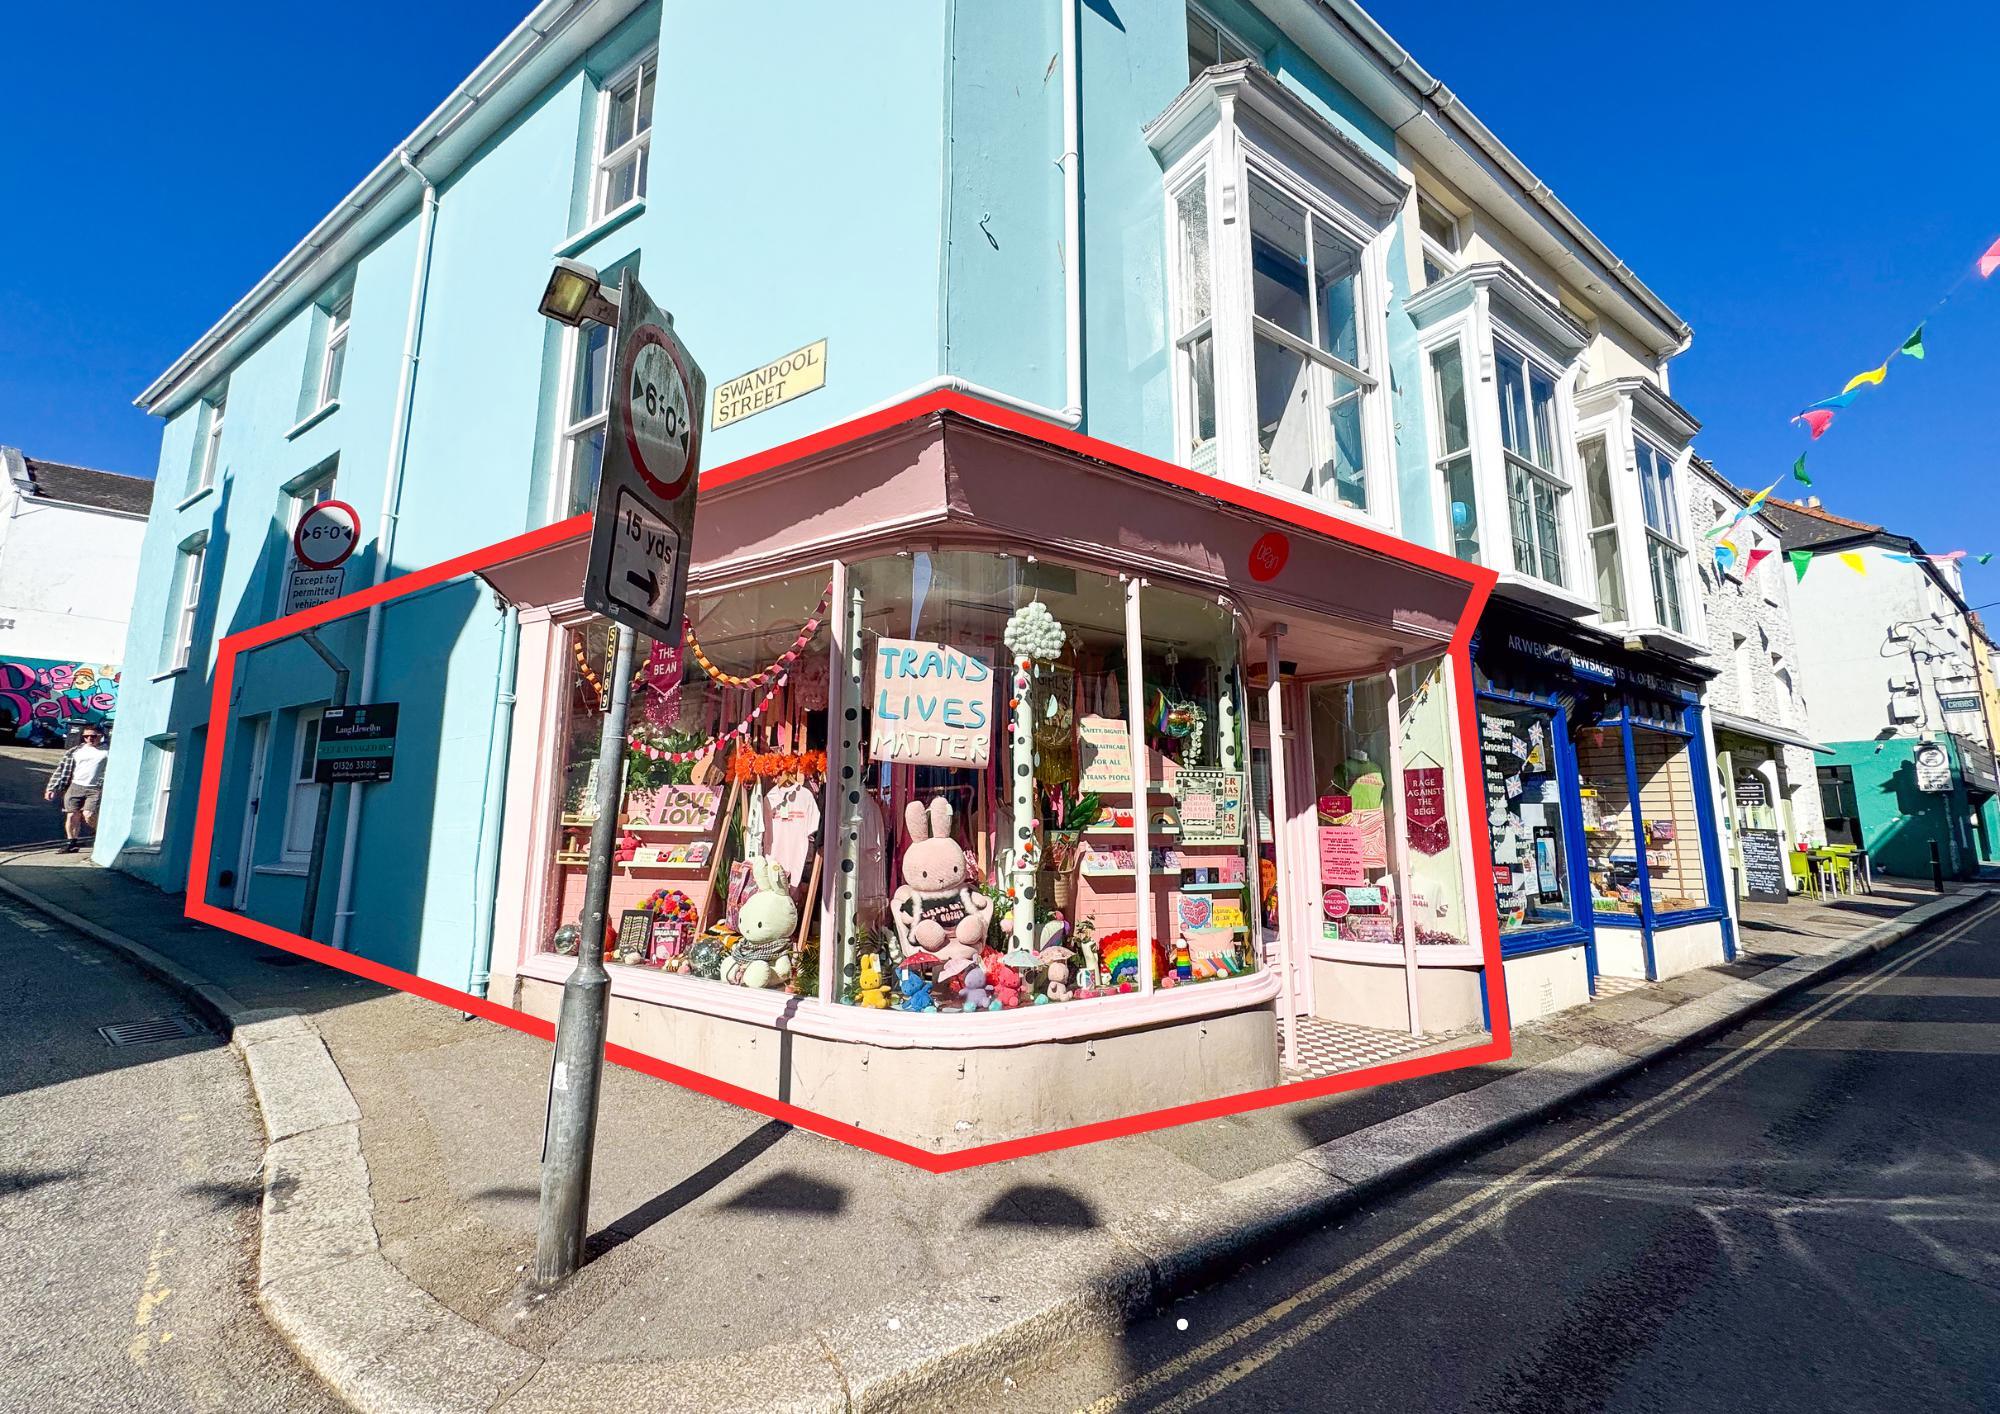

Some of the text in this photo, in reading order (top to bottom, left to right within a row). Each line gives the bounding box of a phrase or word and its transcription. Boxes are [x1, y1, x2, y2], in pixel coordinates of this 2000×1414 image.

[719, 348, 819, 404] SWANPOOL
[719, 381, 786, 422] STREET
[625, 509, 672, 565] 15 yds
[294, 574, 339, 586] Except for
[293, 586, 335, 598] permitted
[658, 647, 676, 660] THE
[653, 661, 678, 676] BEAN
[879, 648, 988, 682] TRANS
[0, 663, 77, 690] Dig
[0, 690, 116, 727] Delve
[878, 689, 986, 729] LIVES
[872, 728, 989, 763] MATTER
[1484, 741, 1511, 754] Groceries
[333, 761, 354, 770] 01326
[1485, 755, 1499, 767] Milk
[1486, 768, 1504, 780] Beers
[1412, 779, 1436, 787] RAGE
[1487, 782, 1506, 794] Wines
[1407, 787, 1441, 797] AGAINST
[665, 791, 714, 807] LOVE
[1417, 798, 1433, 806] THE
[659, 808, 709, 825] LOVE
[1414, 807, 1437, 816] BEIGE
